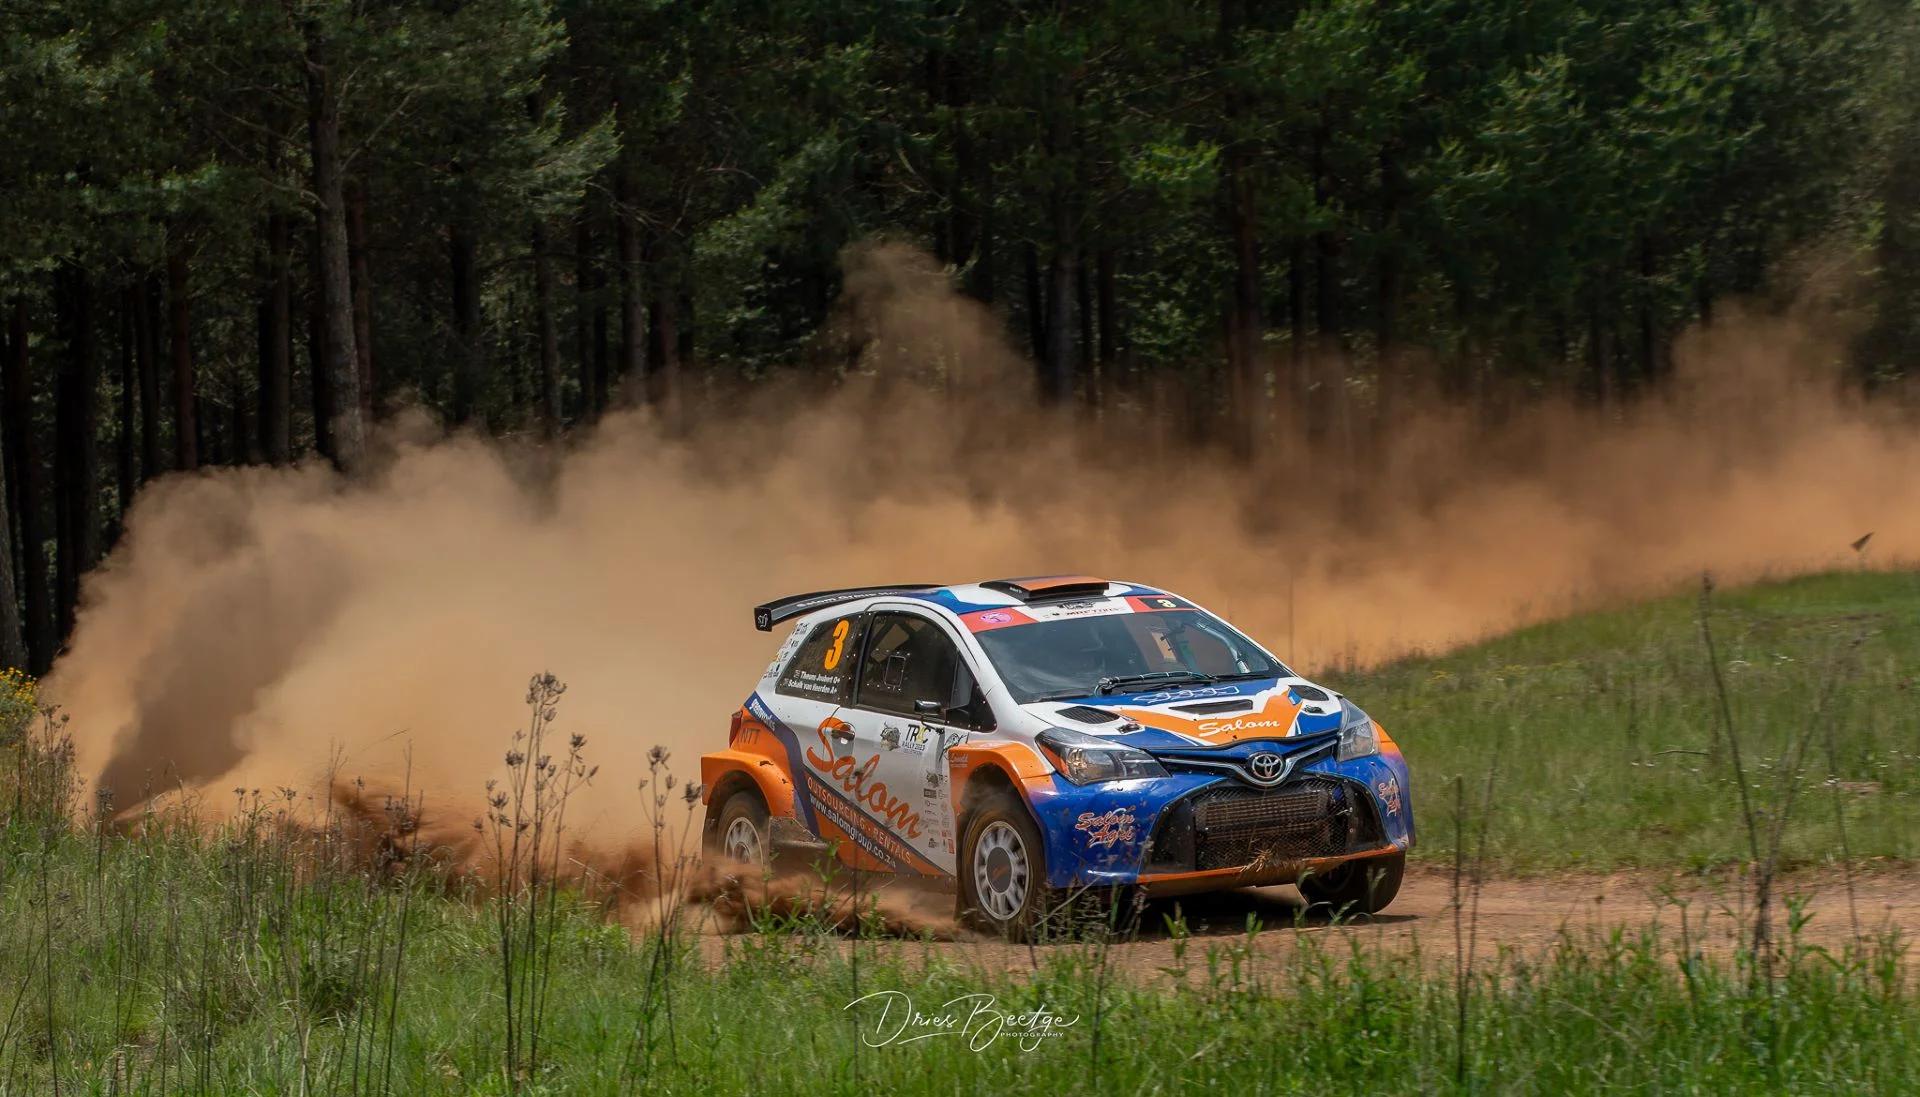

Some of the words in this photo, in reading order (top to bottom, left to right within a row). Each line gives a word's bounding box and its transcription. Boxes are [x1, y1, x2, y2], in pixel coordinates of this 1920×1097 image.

[1156, 599, 1177, 609] 3
[824, 620, 849, 670] 3
[1198, 719, 1280, 737] Salom
[806, 717, 923, 839] Salom
[807, 776, 866, 831] OUTSOURCING
[1075, 808, 1135, 831] Salom
[809, 793, 897, 868] www.salomgroup.co.za
